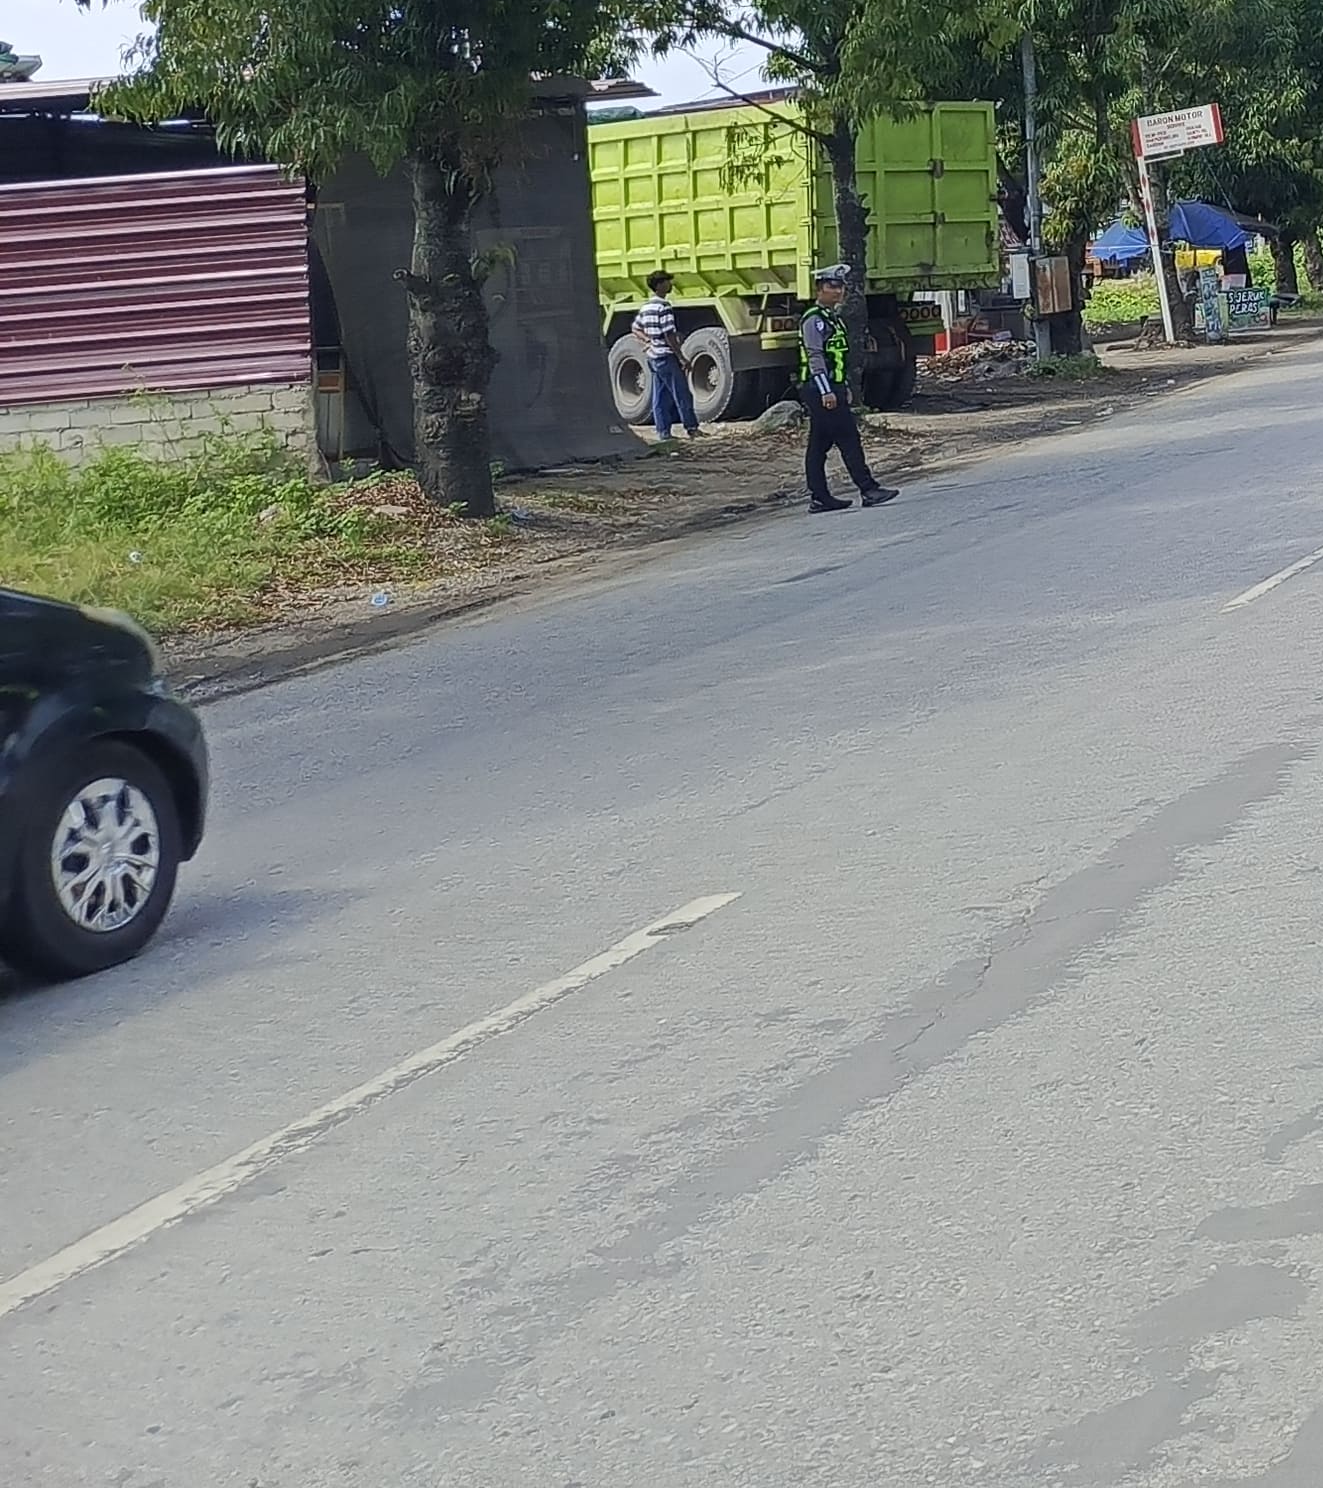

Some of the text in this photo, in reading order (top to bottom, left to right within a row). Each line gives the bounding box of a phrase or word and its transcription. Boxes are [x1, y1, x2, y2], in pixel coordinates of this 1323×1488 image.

[1174, 110, 1203, 122] MOTOR
[1236, 291, 1264, 303] JERUK
[1229, 302, 1258, 314] PERAS
